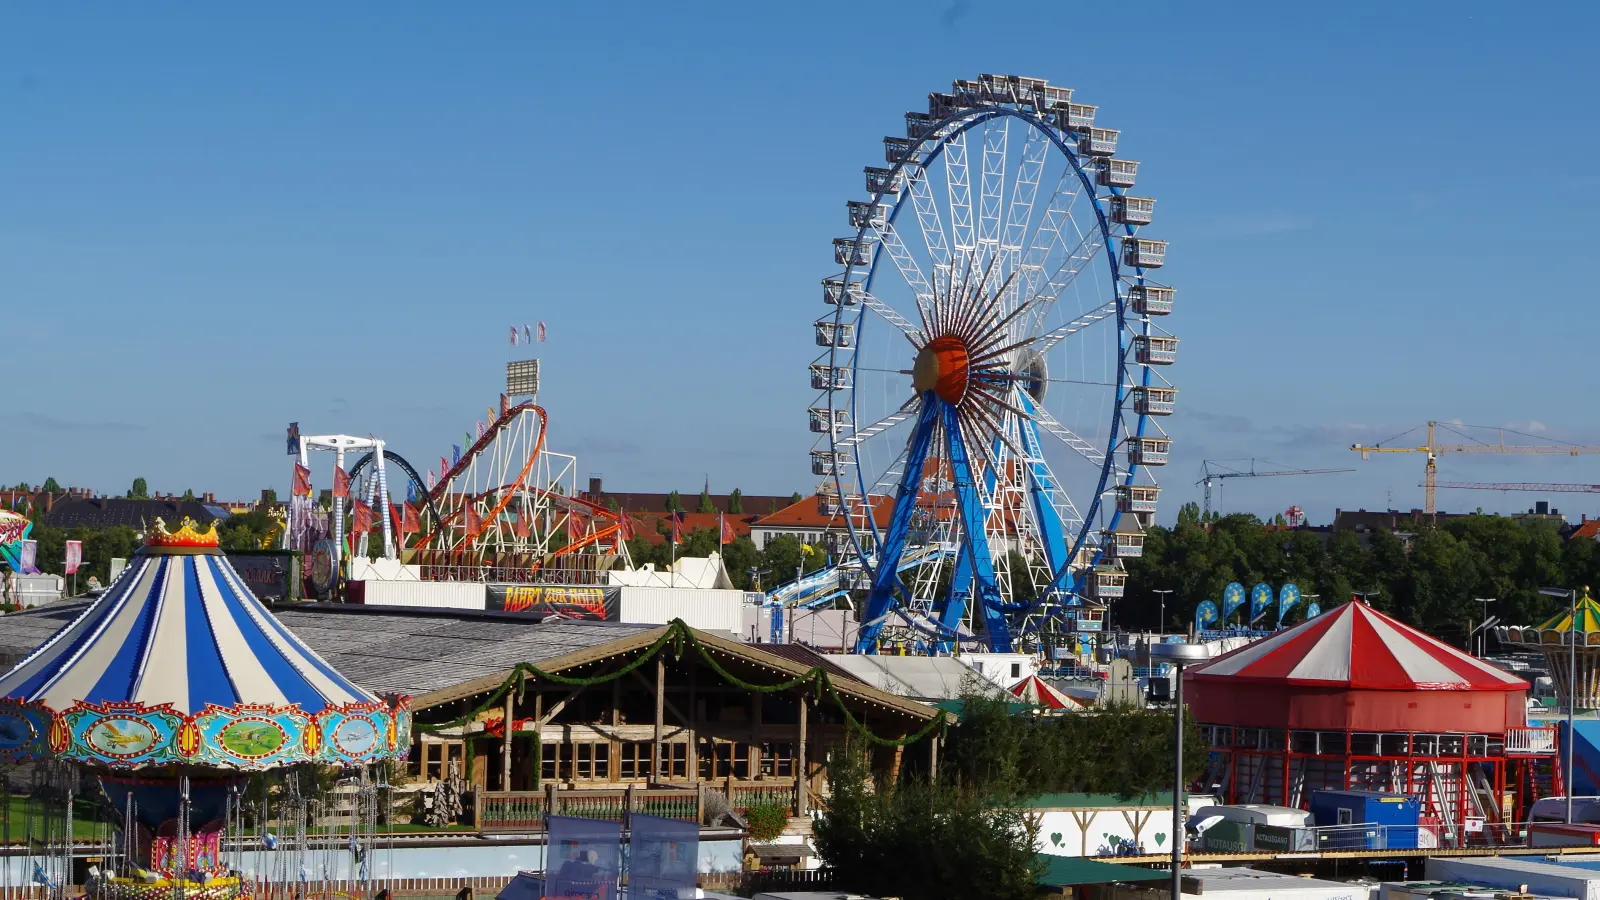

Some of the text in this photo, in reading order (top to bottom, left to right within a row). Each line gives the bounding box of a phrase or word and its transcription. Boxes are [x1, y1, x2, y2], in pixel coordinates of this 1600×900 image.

[504, 587, 542, 612] FAHRT
[544, 588, 567, 603] ZUR
[1255, 833, 1288, 845] NOTAUSGANG
